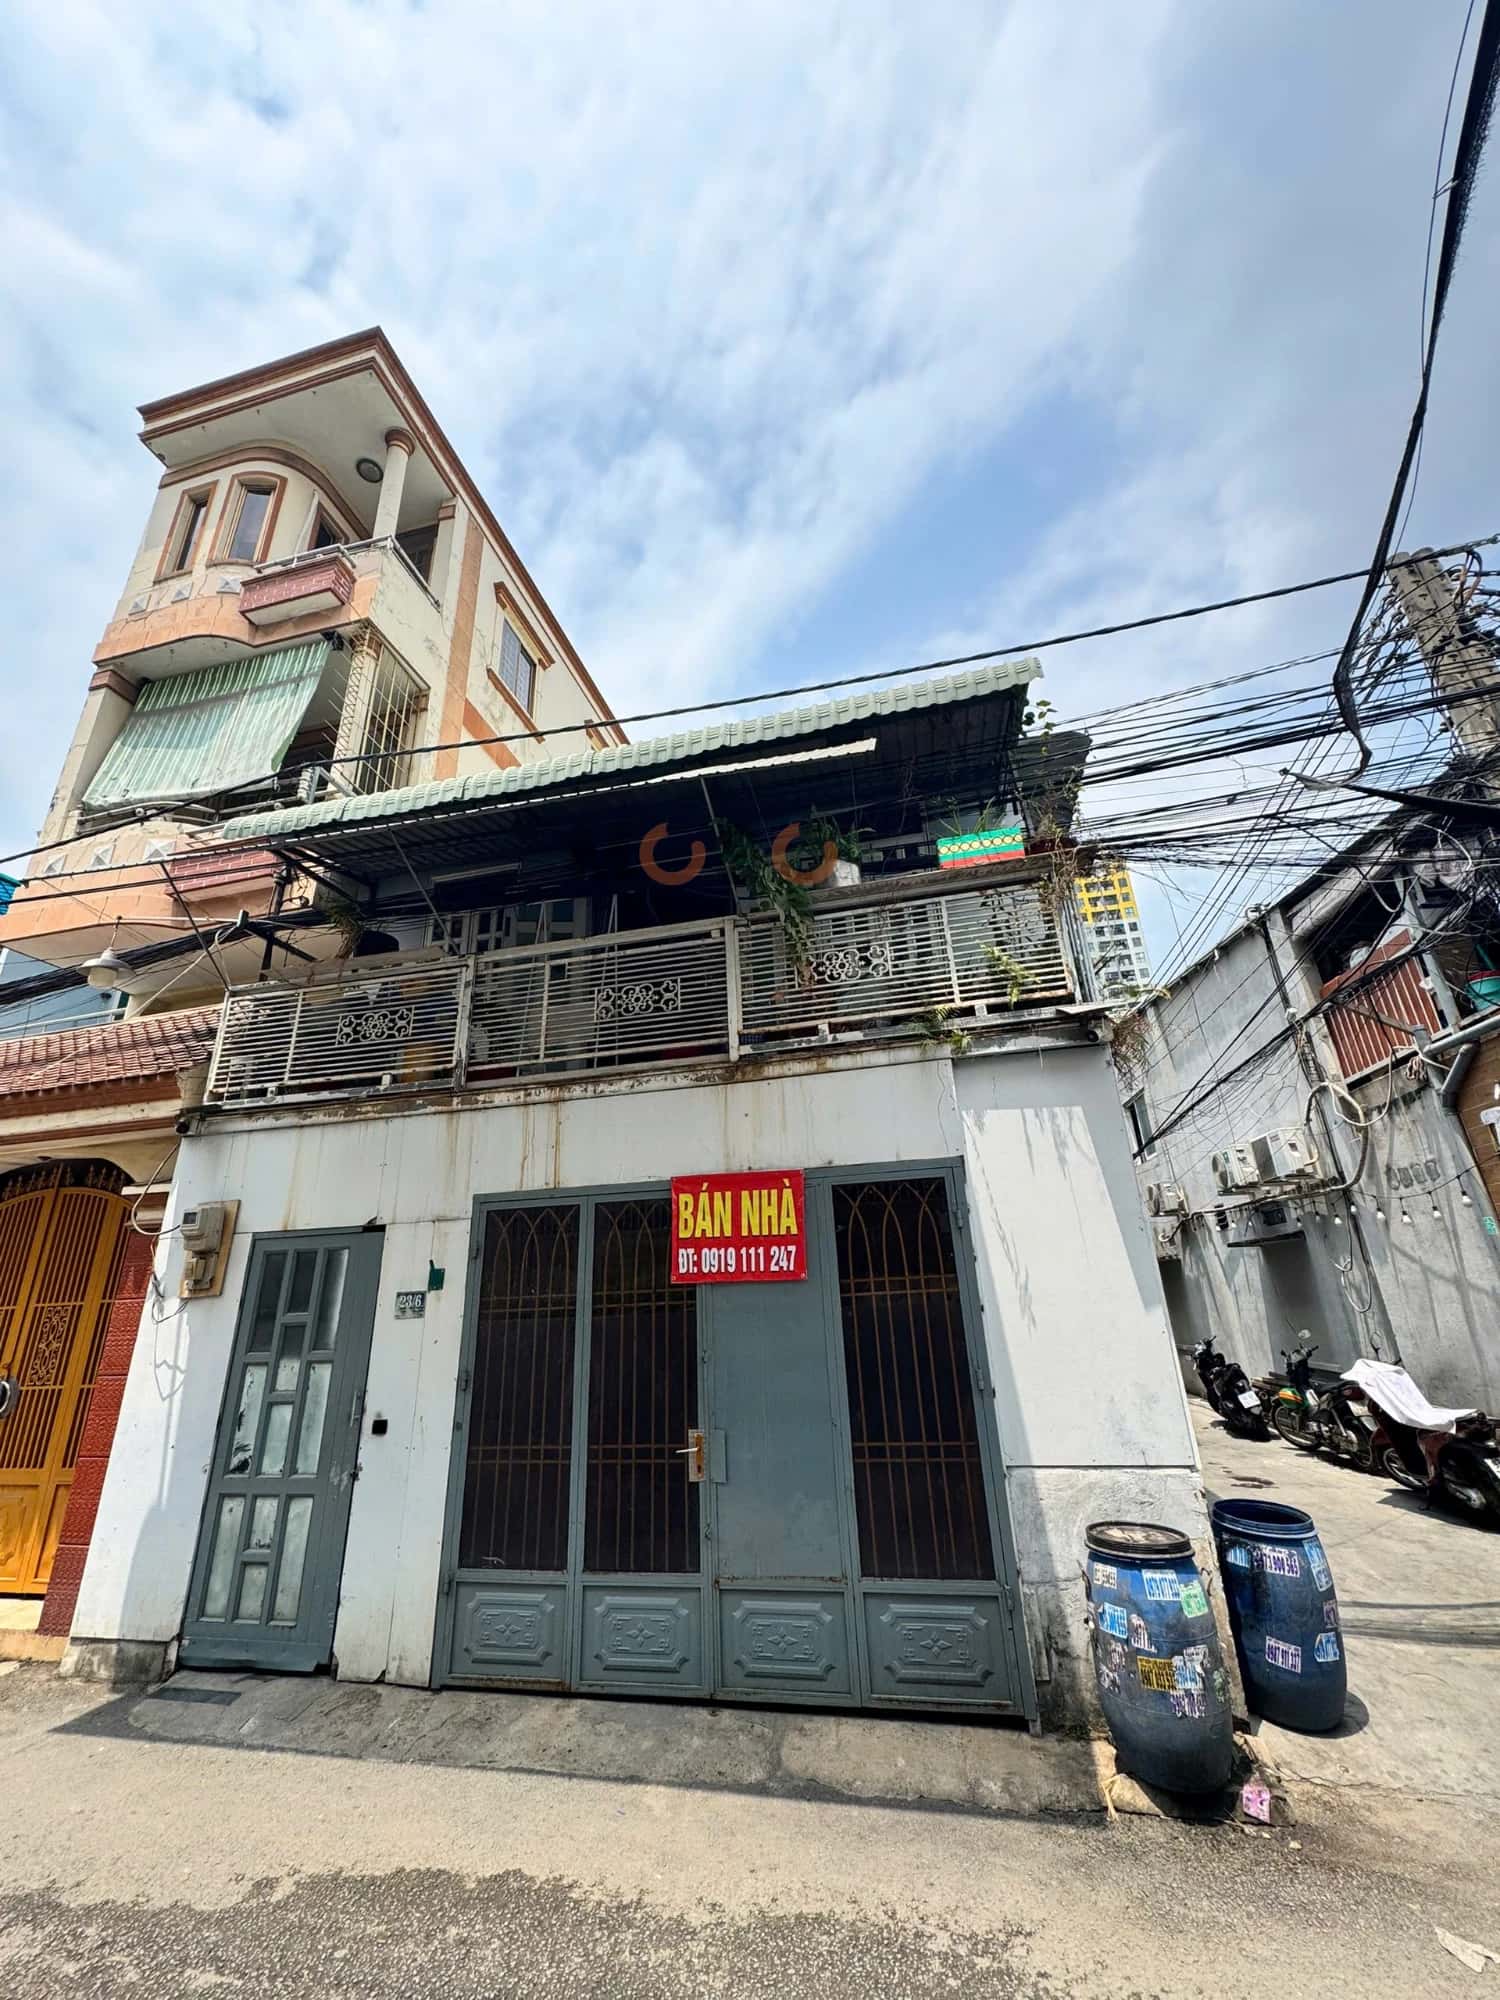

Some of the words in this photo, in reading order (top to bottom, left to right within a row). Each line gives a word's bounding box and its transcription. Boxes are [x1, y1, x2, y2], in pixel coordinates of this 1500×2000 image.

[678, 1182, 732, 1239] BÁN
[740, 1178, 798, 1237] NHÀ
[678, 1248, 697, 1274] ĐT:
[701, 1247, 736, 1273] 0919
[740, 1246, 765, 1272] 111
[770, 1245, 797, 1272] 247
